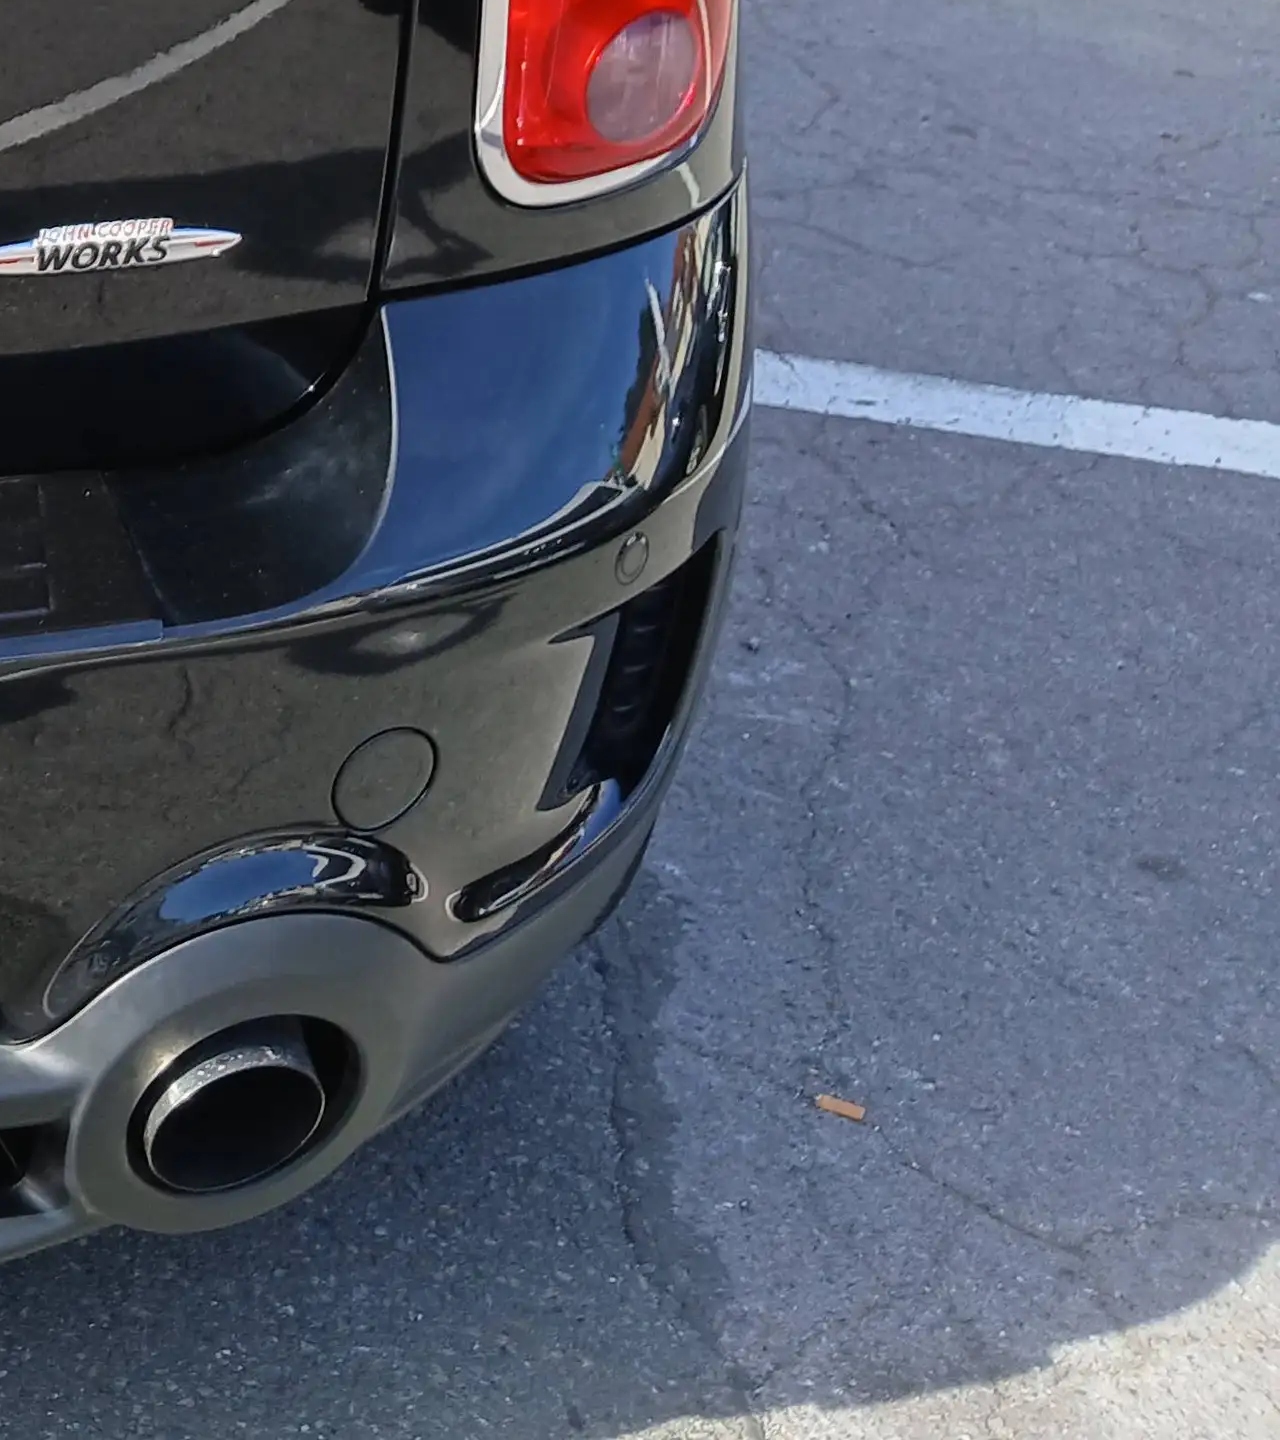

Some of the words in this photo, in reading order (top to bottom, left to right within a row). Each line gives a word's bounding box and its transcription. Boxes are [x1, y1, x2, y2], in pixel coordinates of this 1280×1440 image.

[39, 224, 94, 242] JOHN
[95, 219, 172, 239] COOPER
[36, 236, 170, 271] WORKS
